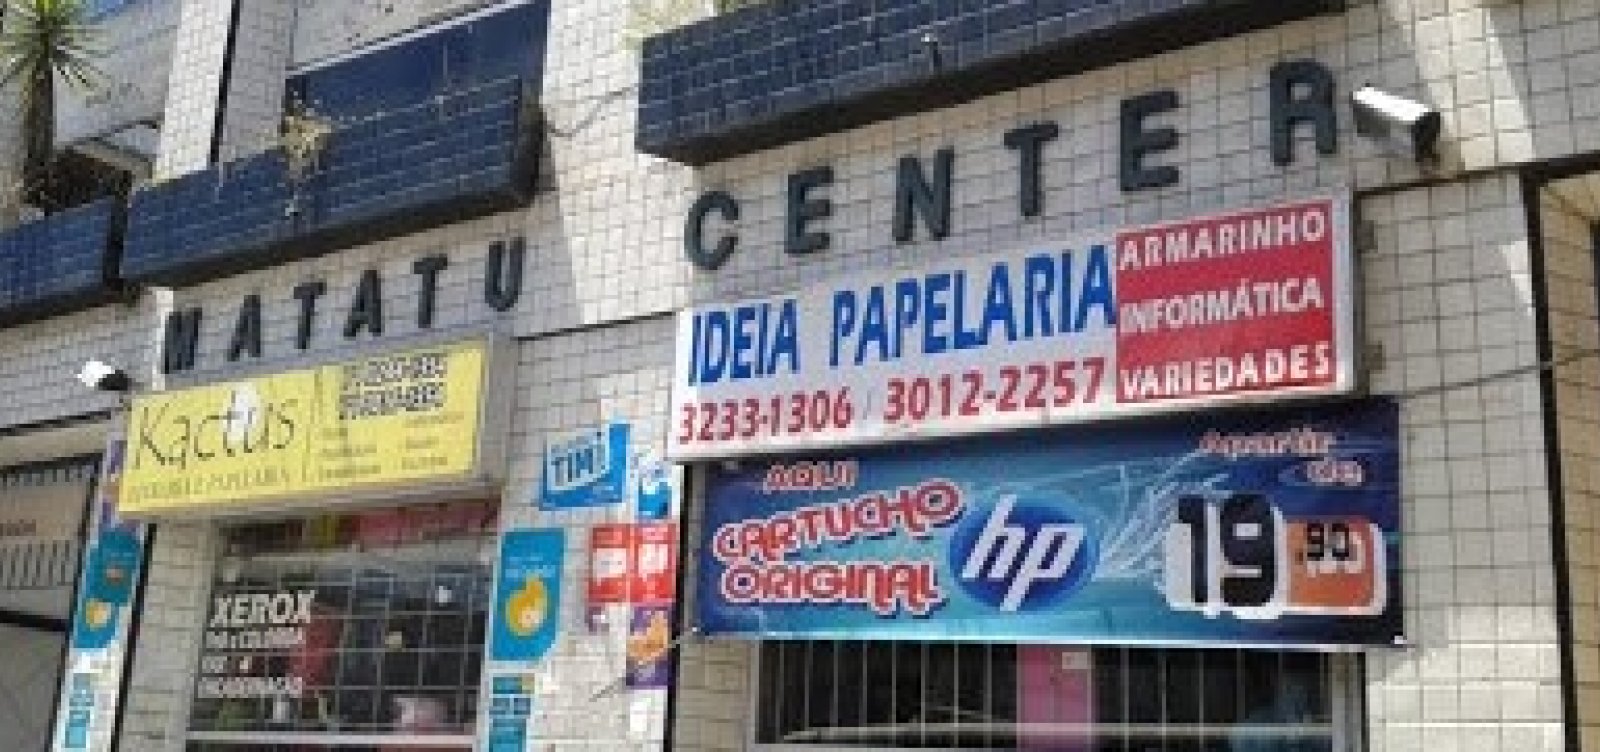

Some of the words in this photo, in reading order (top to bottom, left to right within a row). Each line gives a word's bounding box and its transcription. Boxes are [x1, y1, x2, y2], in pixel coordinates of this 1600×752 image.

[162, 236, 526, 375] MATATU
[683, 60, 1339, 271] CENTER
[1118, 211, 1326, 271] ARMARINHO
[689, 299, 799, 387] IDEIA
[829, 244, 1117, 367] PAPELARIA
[1118, 277, 1323, 335] INFORMÁTICA
[678, 387, 852, 444] 3233-1306
[884, 356, 1105, 424] 3012-2257
[1119, 342, 1331, 400] VARIEDADES
[134, 388, 299, 469] Kactus
[712, 478, 963, 564] CARTUCHO
[960, 495, 1085, 612] hp
[1176, 493, 1277, 609] 19
[208, 590, 316, 629] XEROX
[721, 560, 946, 616] ORIGINAL
